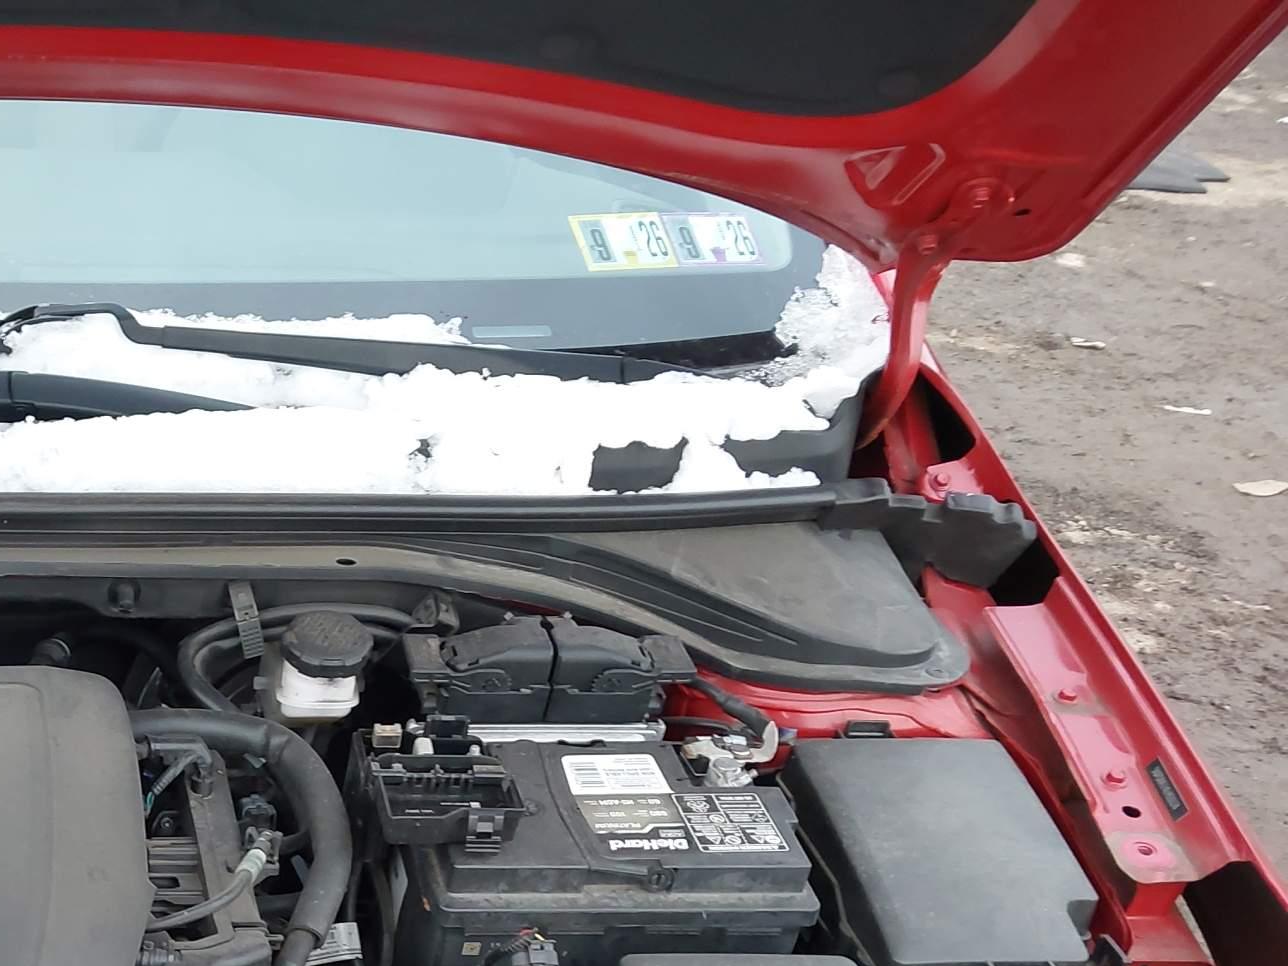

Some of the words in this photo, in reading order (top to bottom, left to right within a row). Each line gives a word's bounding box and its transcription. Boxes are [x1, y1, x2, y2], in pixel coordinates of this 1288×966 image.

[638, 220, 669, 257] 26
[725, 219, 756, 256] 26
[608, 838, 690, 851] DieHard
